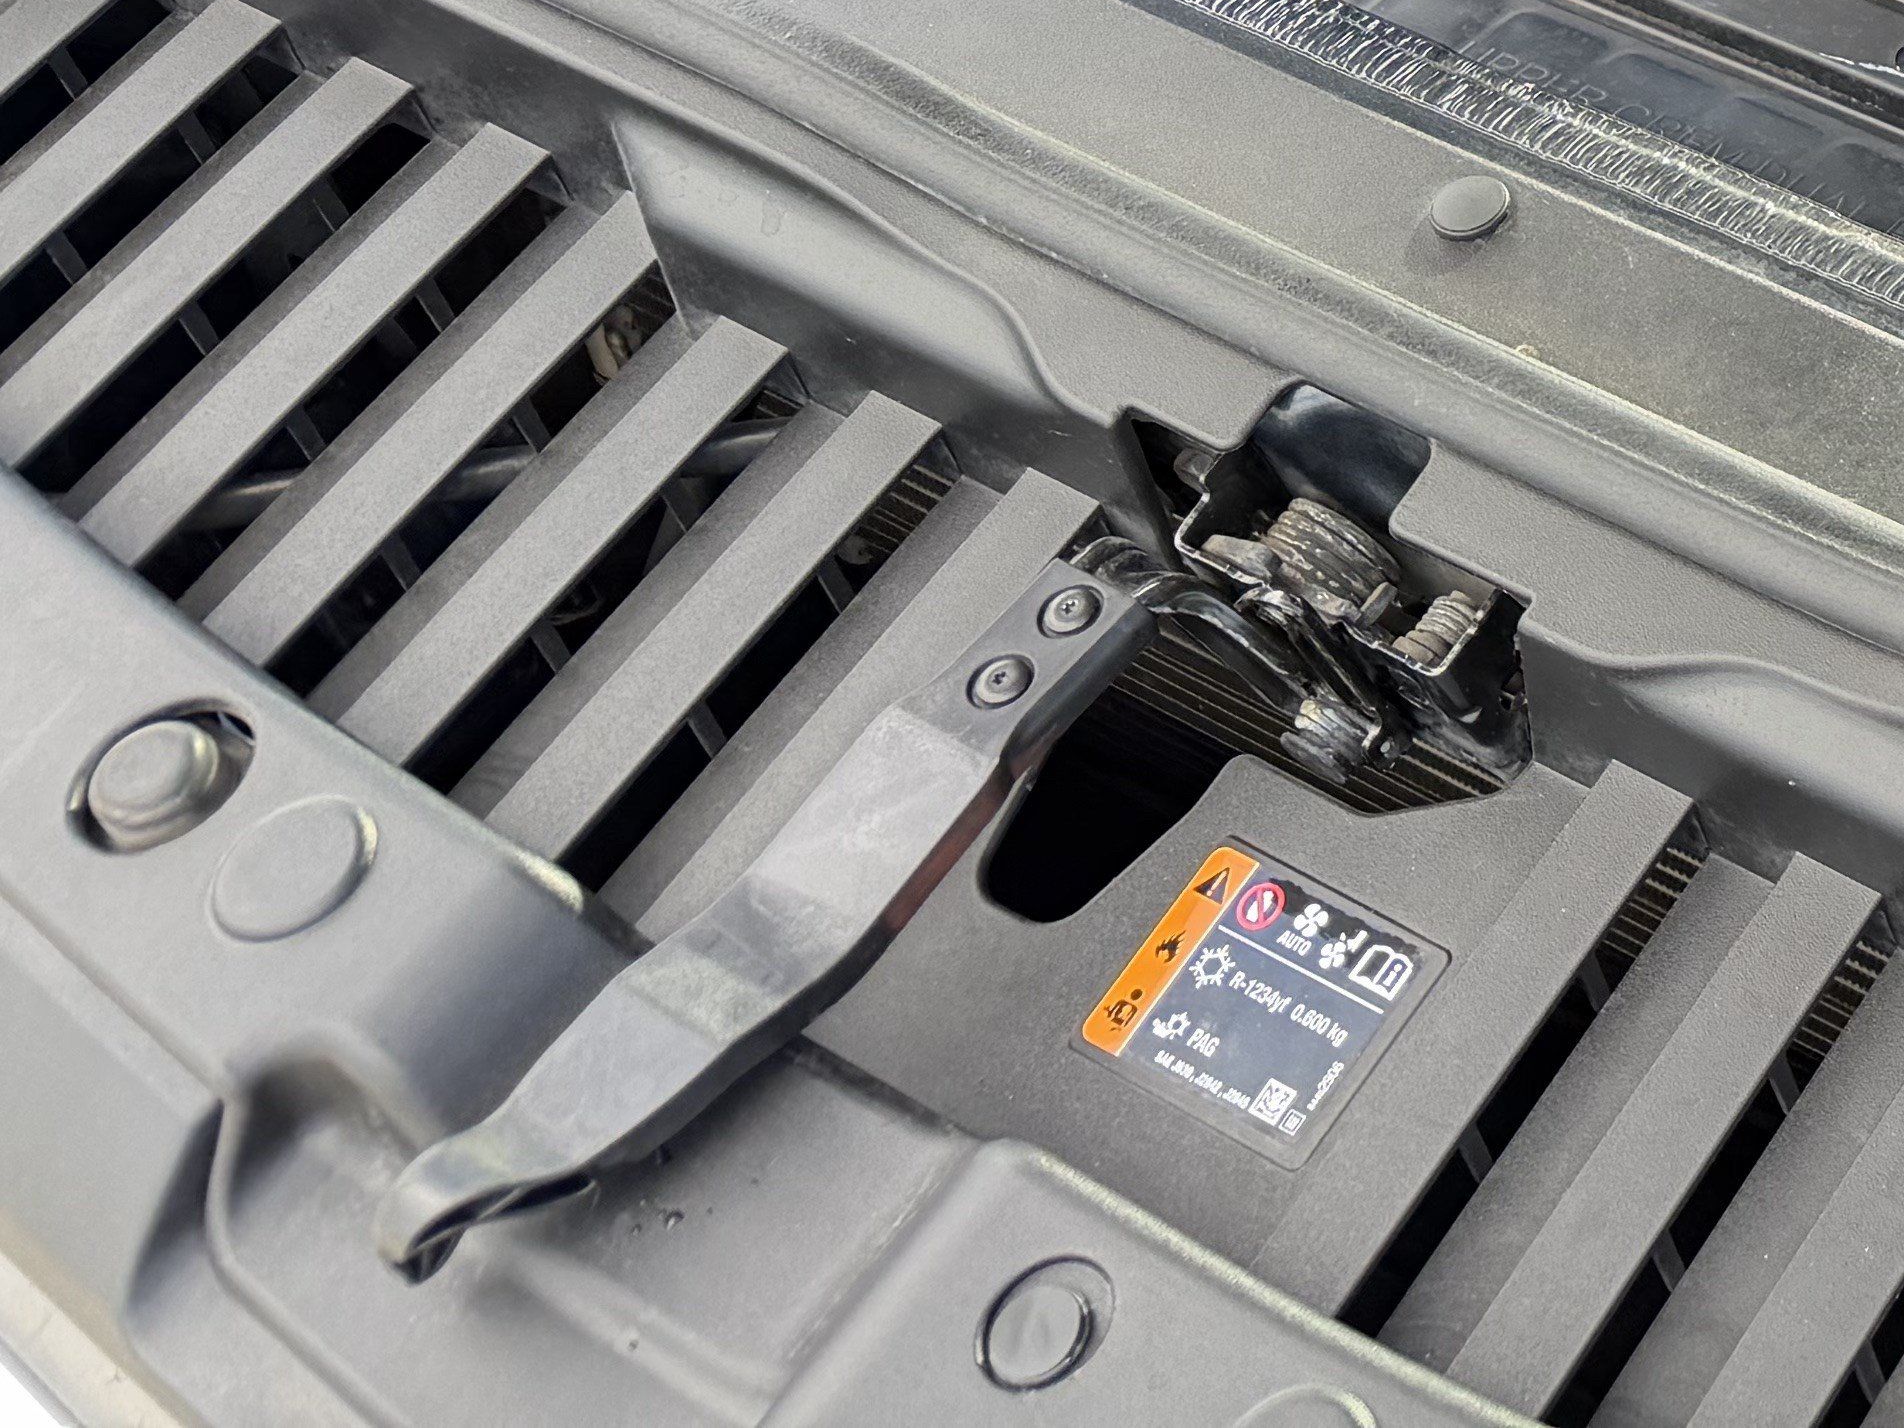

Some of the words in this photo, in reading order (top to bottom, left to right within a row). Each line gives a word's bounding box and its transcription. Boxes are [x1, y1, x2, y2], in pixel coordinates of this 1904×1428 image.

[1276, 930, 1311, 955] AUTO
[1226, 971, 1291, 1016] R-1234yf
[1324, 1023, 1350, 1047] kg
[1186, 1028, 1221, 1056] PAG
